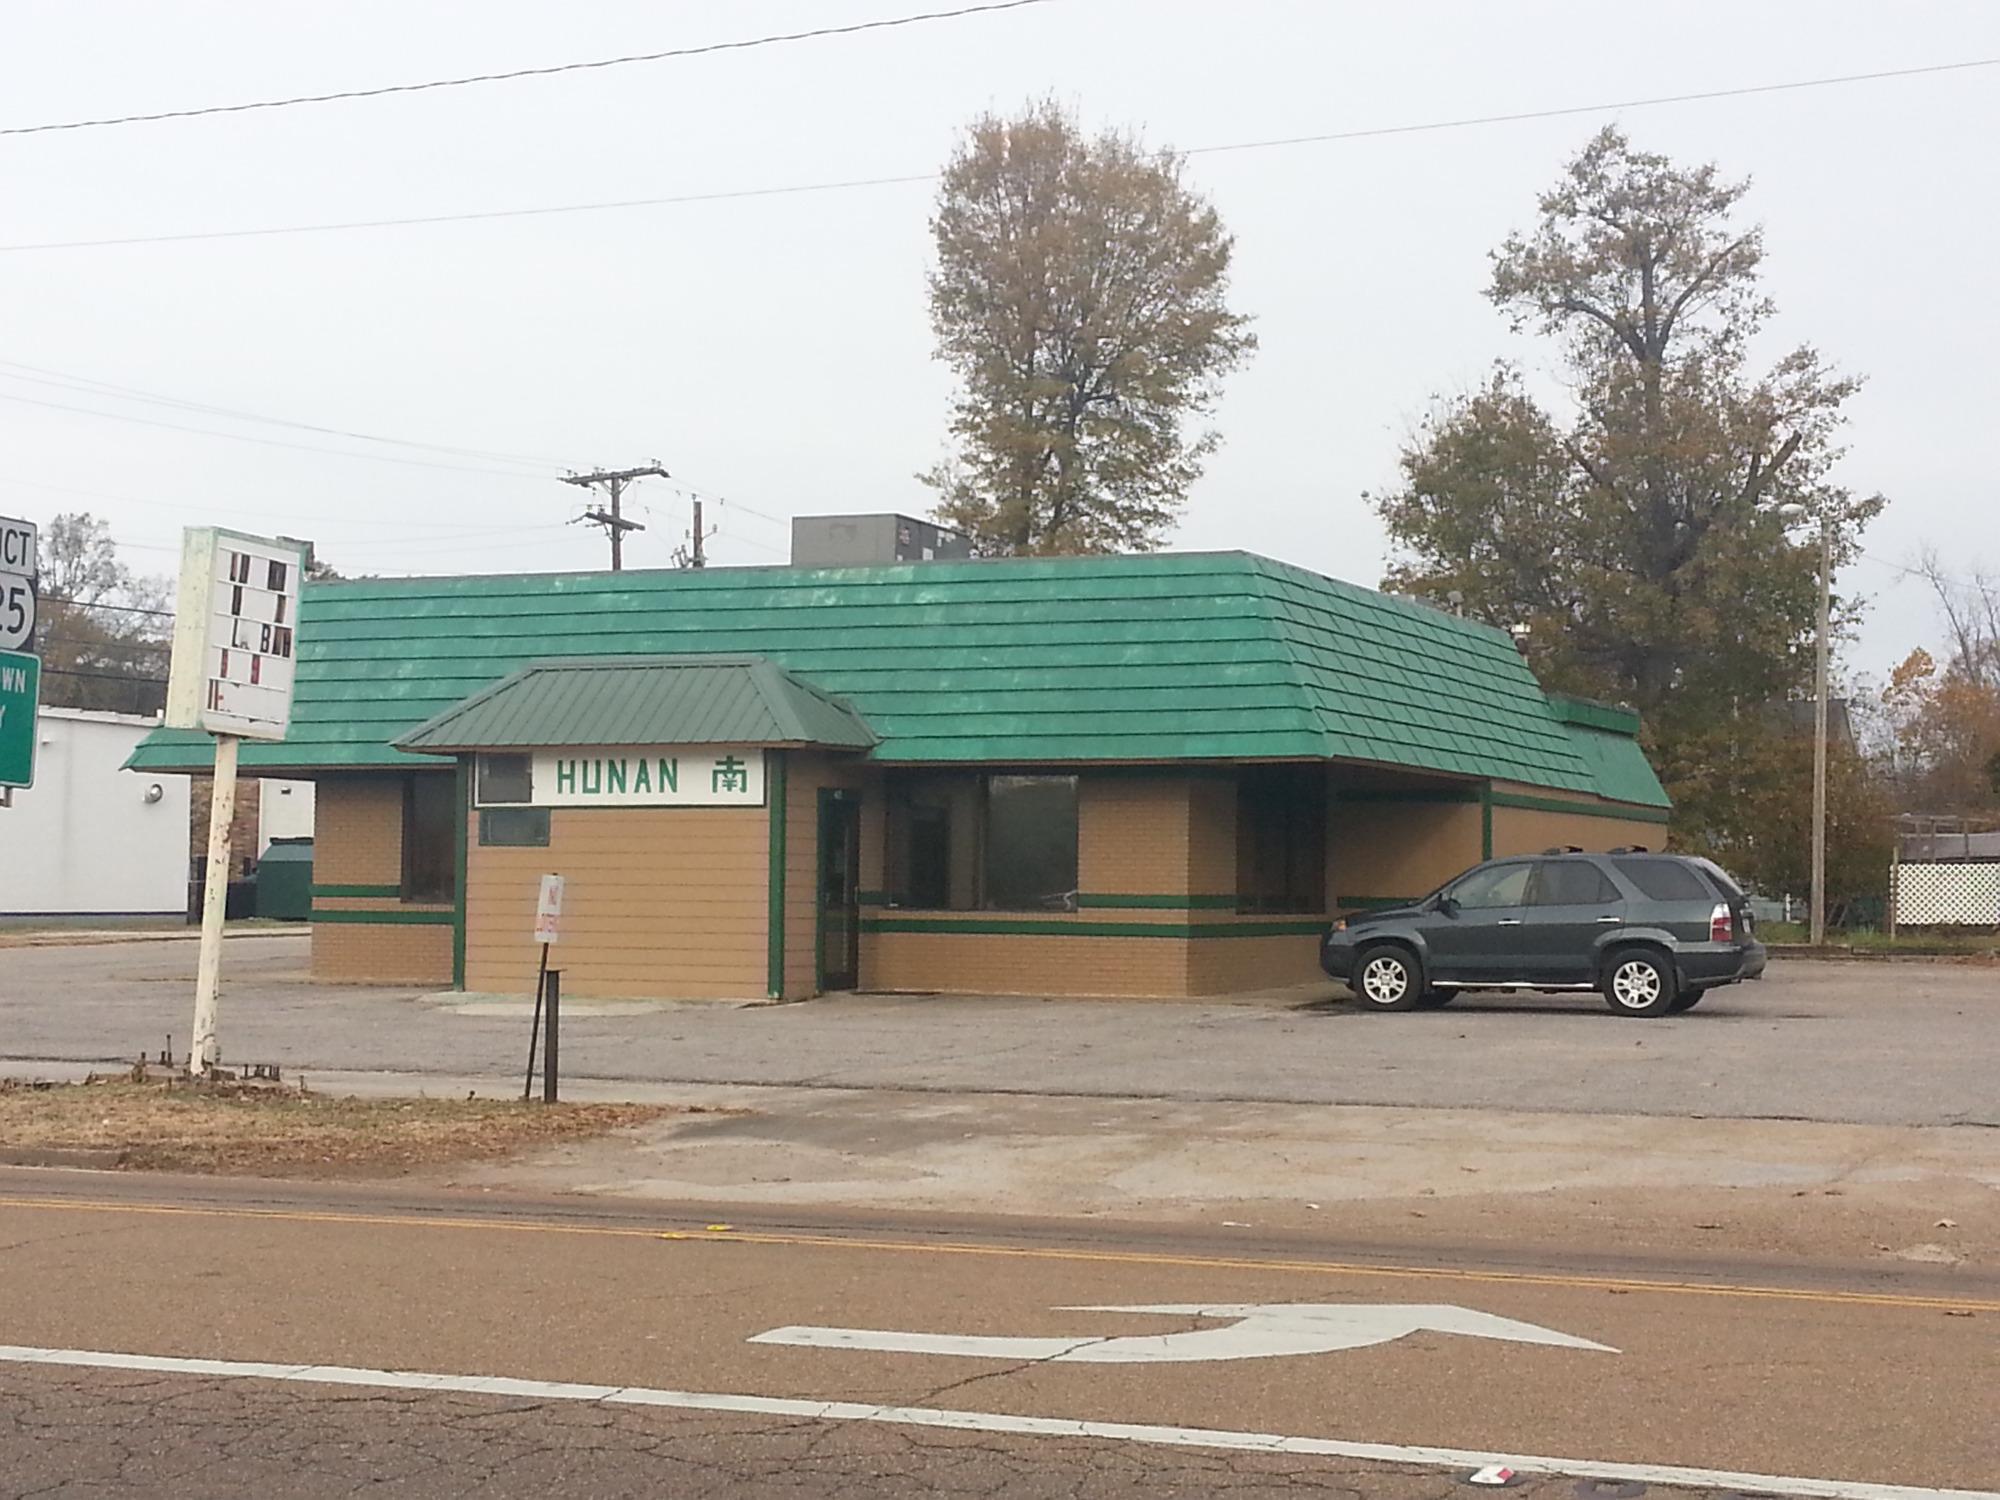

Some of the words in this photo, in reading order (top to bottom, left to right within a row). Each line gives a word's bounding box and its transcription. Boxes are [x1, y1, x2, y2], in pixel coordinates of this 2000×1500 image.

[0, 528, 31, 567] CT
[557, 758, 678, 794] HUNAN
[712, 755, 747, 793] 南
